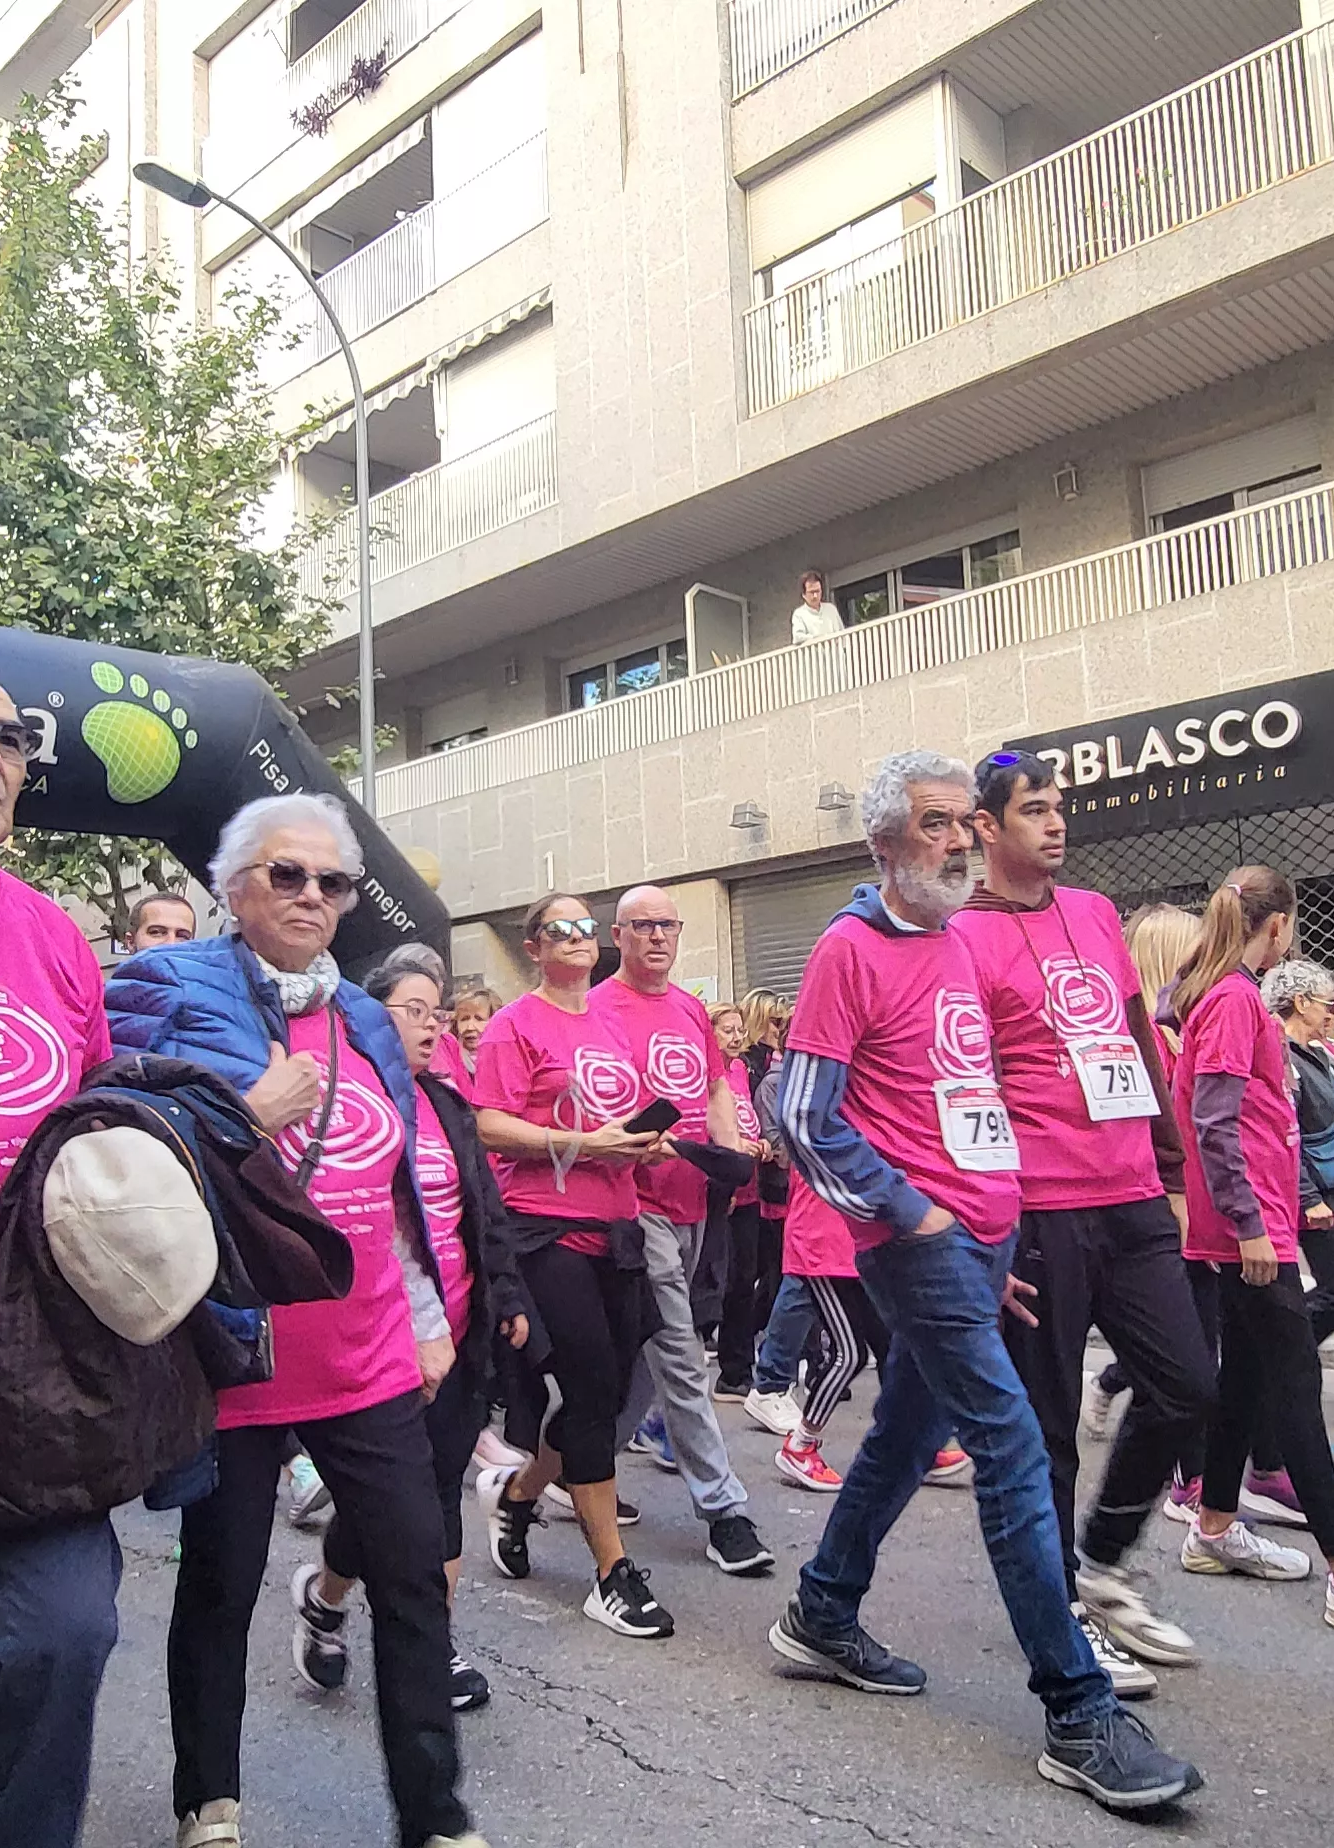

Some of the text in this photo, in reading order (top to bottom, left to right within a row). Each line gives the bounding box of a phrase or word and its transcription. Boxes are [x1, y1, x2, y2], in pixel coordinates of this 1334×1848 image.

[1071, 764, 1287, 814] inmobiliaria
[249, 738, 416, 934] Pisa mejor
[1100, 1063, 1138, 1094] 797
